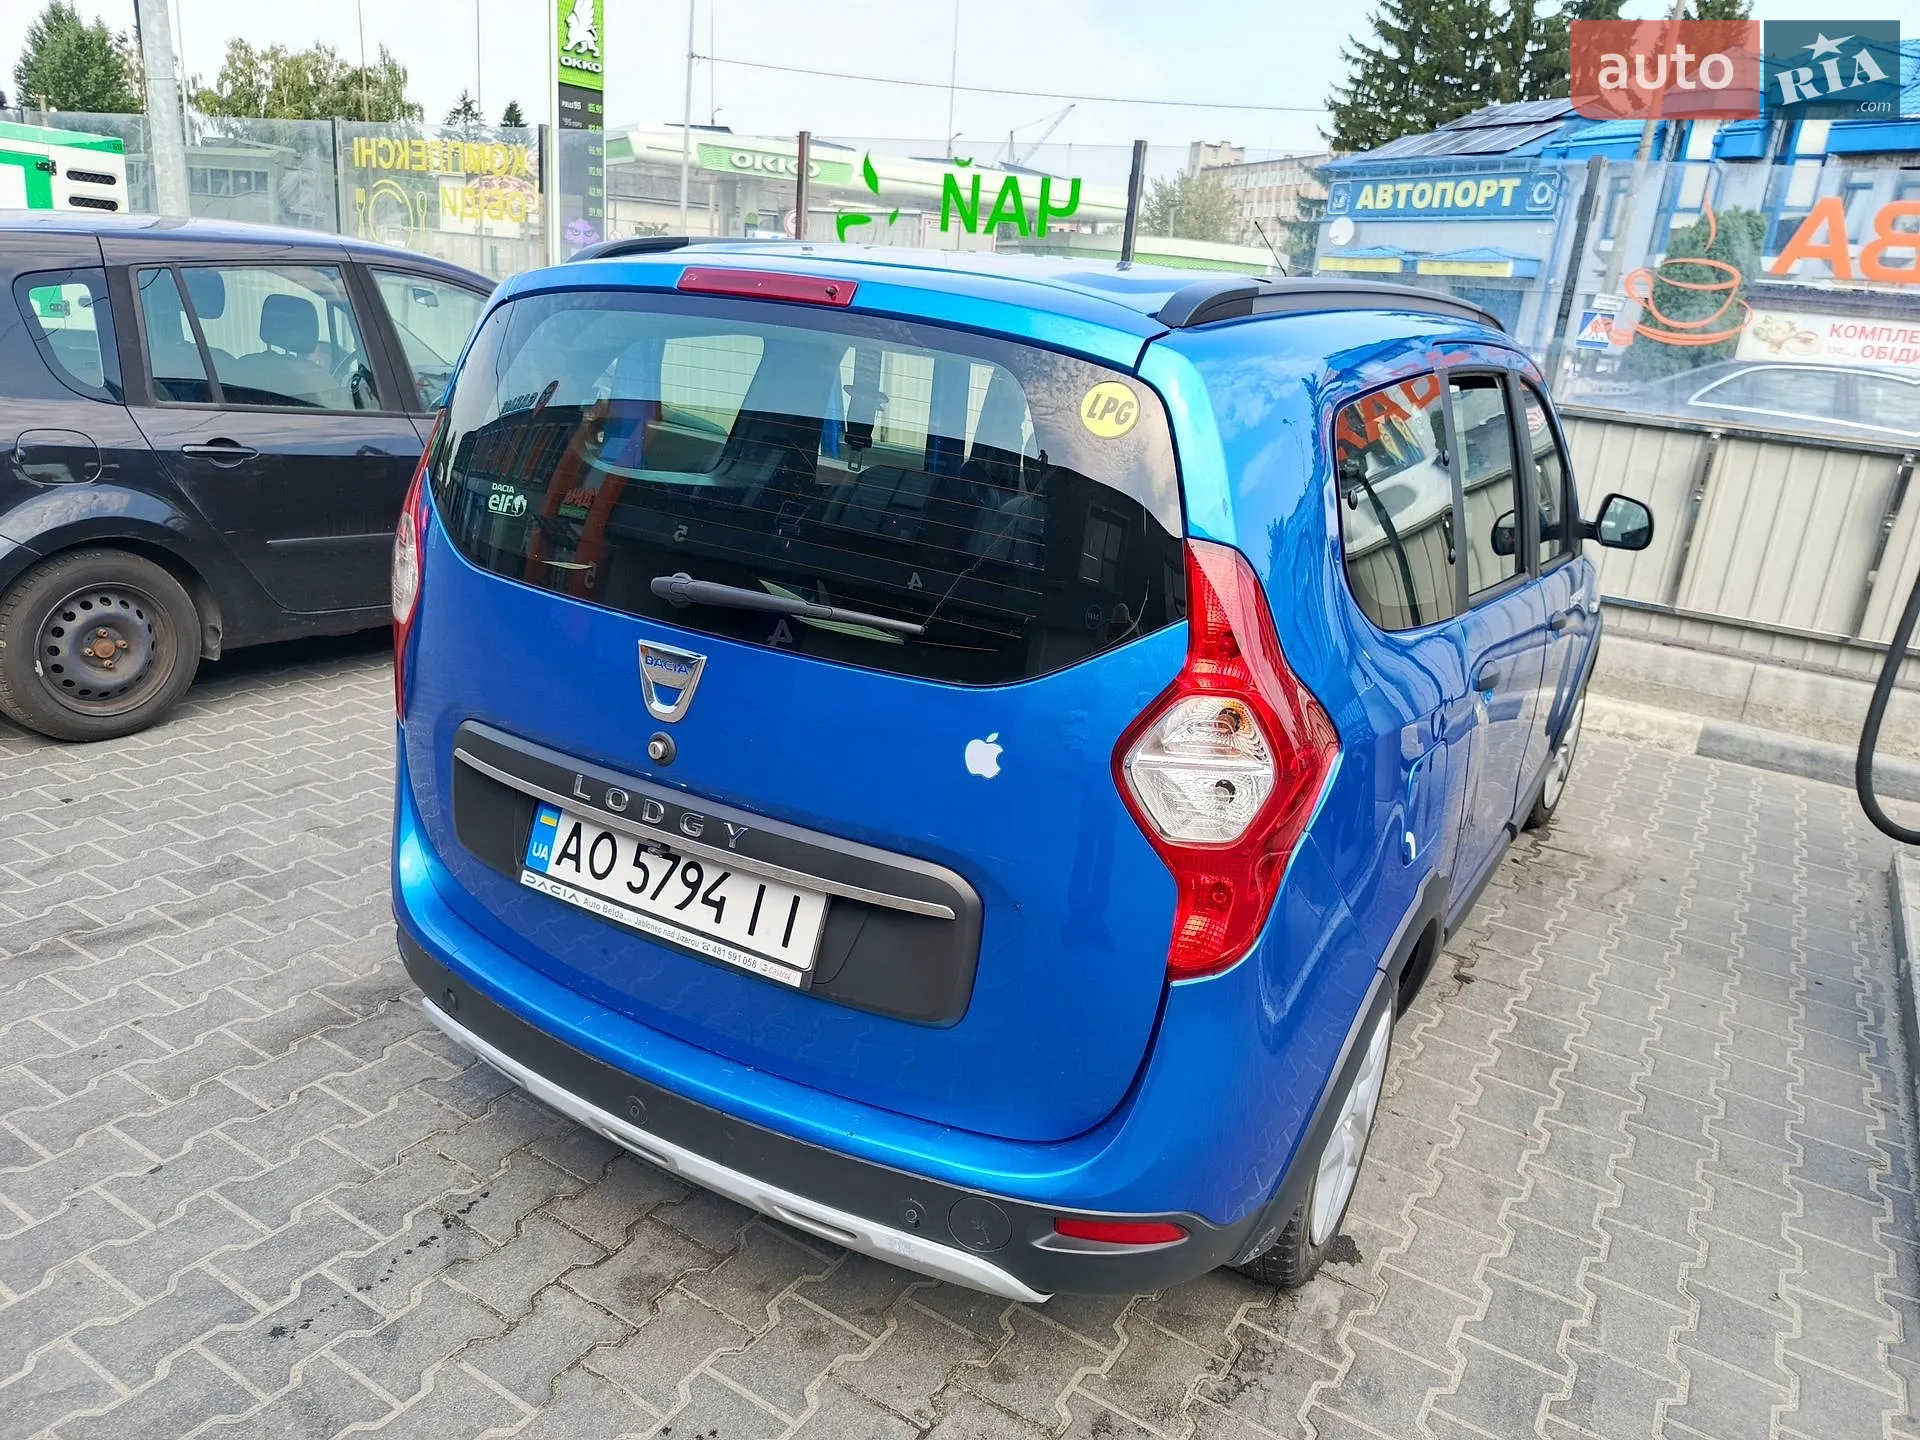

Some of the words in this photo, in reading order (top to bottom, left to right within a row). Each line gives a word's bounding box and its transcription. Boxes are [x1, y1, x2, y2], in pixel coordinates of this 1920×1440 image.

[560, 56, 603, 73] OKKO
[1355, 178, 1521, 210] АВТОПОРТ
[1086, 394, 1134, 426] LPG
[491, 482, 515, 494] DACIA
[488, 493, 513, 513] elf
[645, 655, 690, 676] DACIA
[573, 774, 748, 849] LODGY
[531, 841, 549, 861] UA
[626, 842, 732, 925] 5794
[525, 874, 579, 903] DACIA
[583, 898, 601, 911] Auto
[602, 904, 625, 920] Belda
[634, 917, 662, 934] Jablonec
[663, 929, 675, 939] nad
[711, 946, 726, 957] 481
[727, 951, 742, 963] 591
[742, 956, 757, 969] 058
